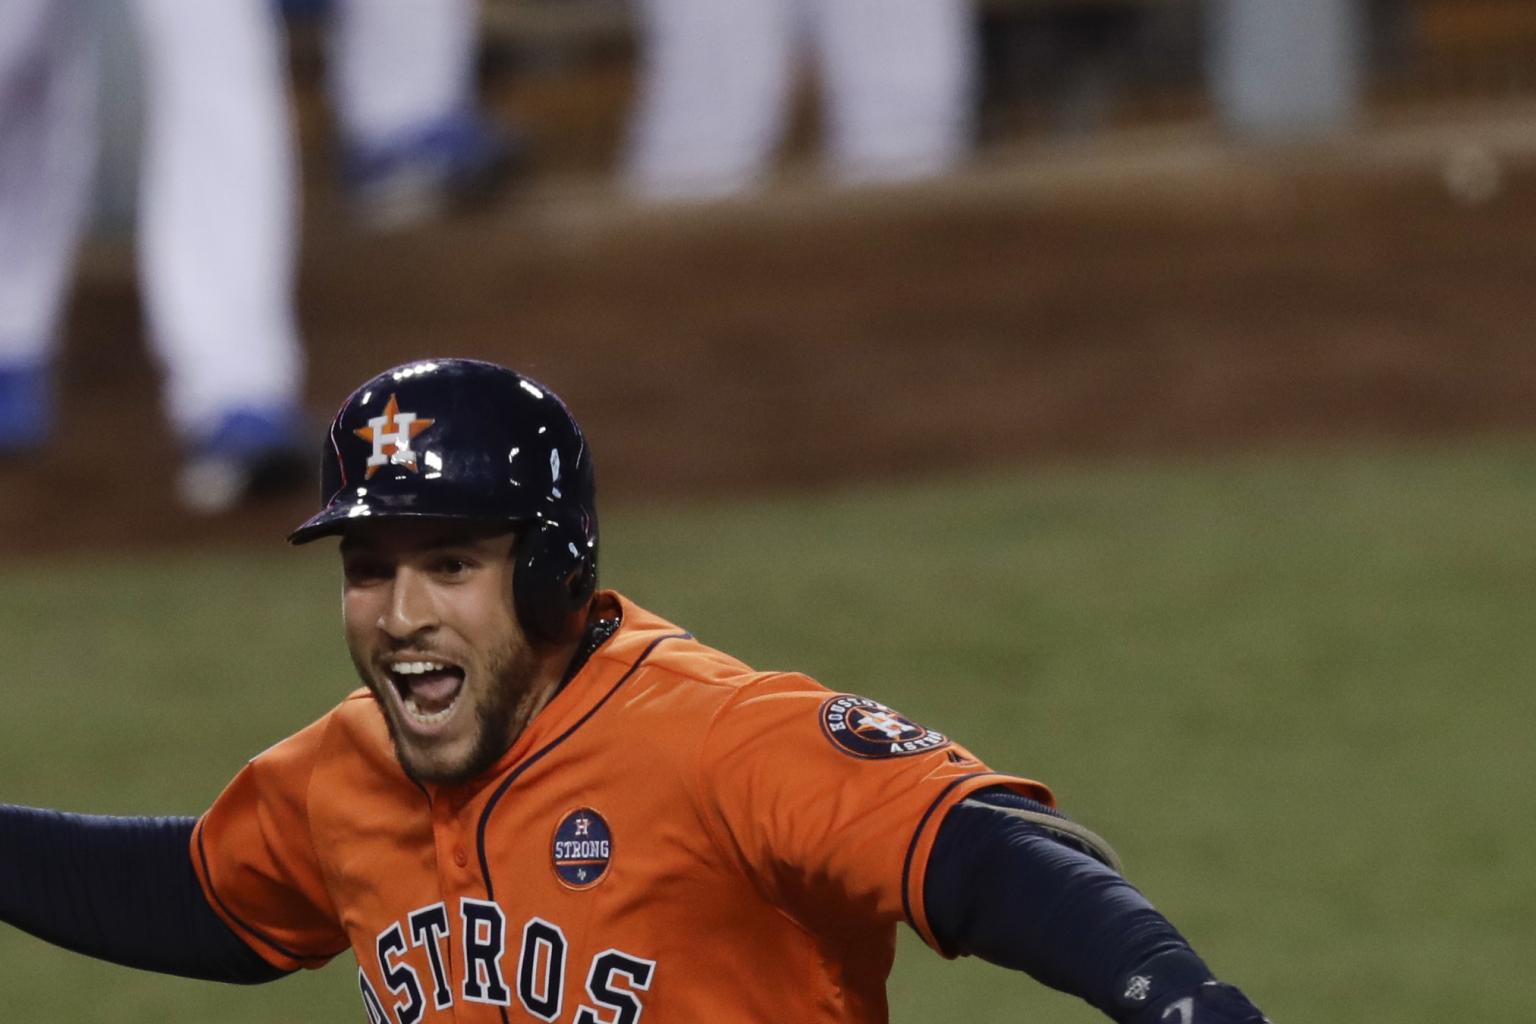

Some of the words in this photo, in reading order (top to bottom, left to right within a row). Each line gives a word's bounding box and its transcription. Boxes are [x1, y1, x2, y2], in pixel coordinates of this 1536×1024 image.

[367, 412, 418, 467] H
[828, 697, 887, 732] HOUSTO
[575, 818, 589, 836] H
[555, 840, 609, 859] STRONG
